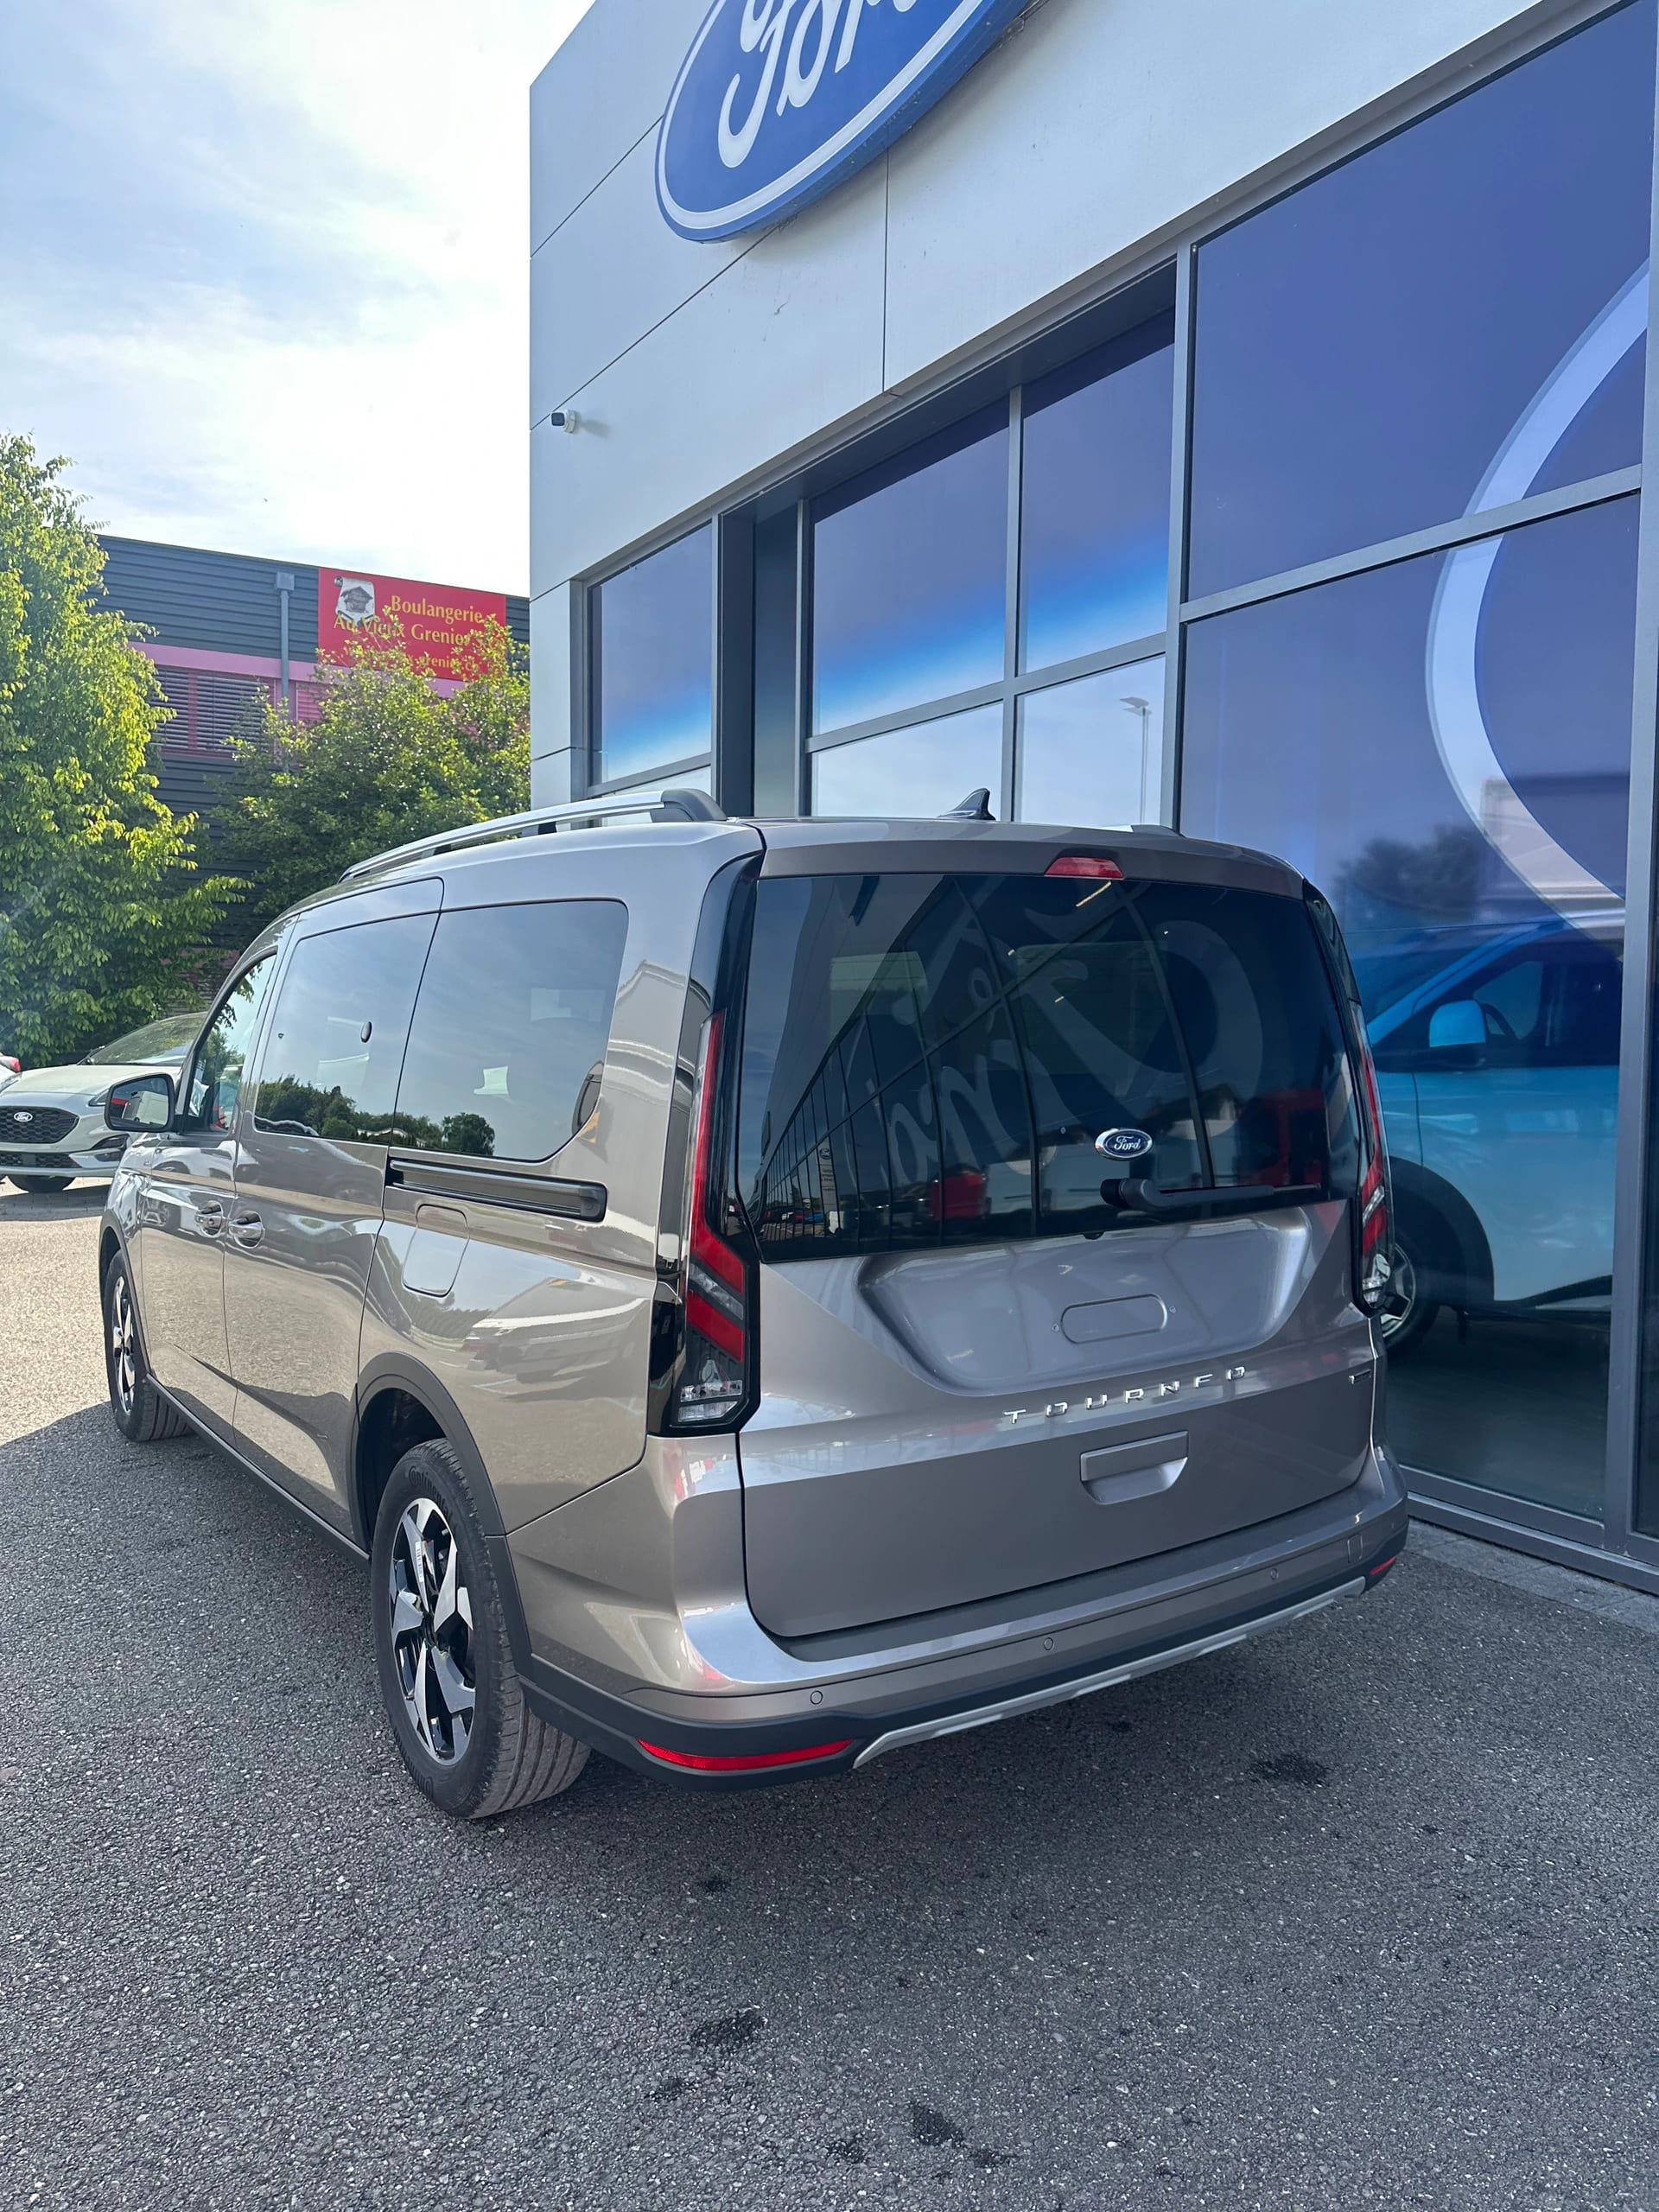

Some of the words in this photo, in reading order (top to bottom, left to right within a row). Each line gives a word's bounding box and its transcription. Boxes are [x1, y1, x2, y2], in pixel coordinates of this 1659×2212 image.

[391, 594, 483, 624] Boulangerie
[334, 613, 355, 632] Au
[1114, 1135, 1141, 1151] Ford
[1003, 1366, 1246, 1424] TOURNEO
